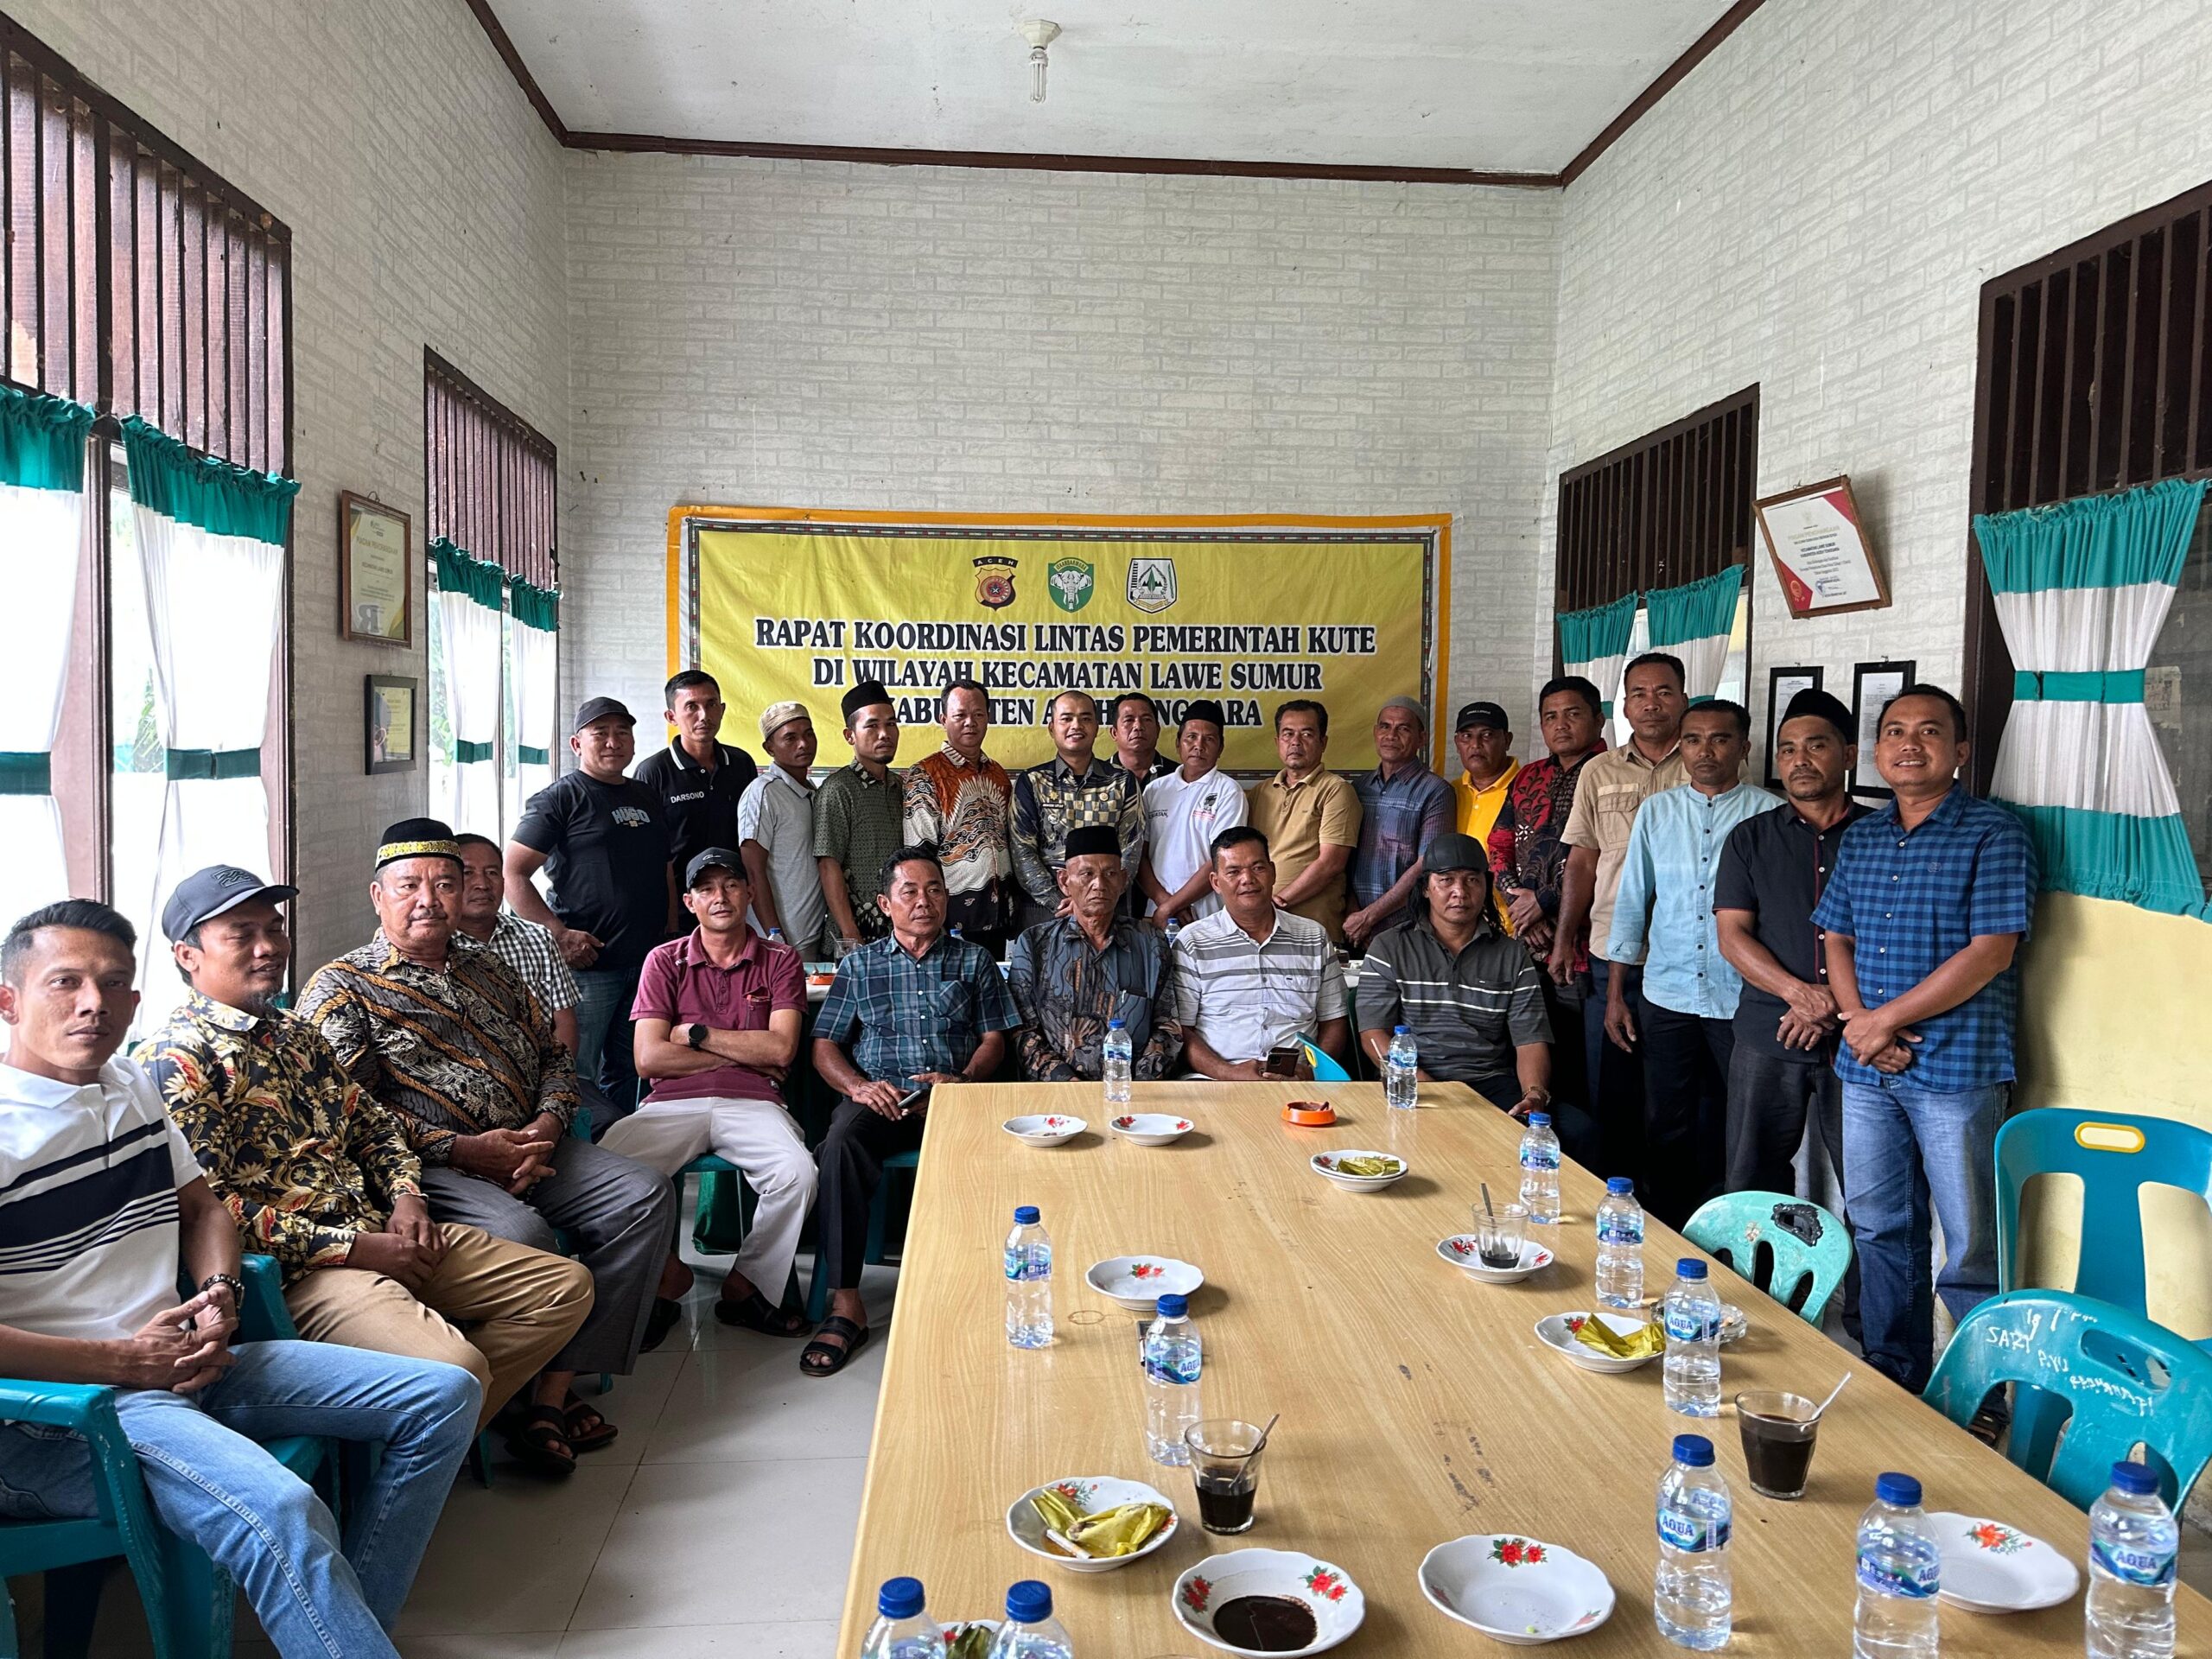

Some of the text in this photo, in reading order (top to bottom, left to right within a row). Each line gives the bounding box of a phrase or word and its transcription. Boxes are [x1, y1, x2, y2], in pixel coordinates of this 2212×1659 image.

[756, 619, 1376, 653] RAPAT KOORDINASI LINTAS PEMERINTAH KUTE
[813, 658, 1323, 690] DI WILAYAH KECAMATAN LAWE SUMUR
[889, 697, 1034, 725] ABUTEN
[1042, 699, 1114, 725] AH
[671, 791, 705, 804] DARSONO
[611, 808, 651, 824] HUGO
[1669, 1316, 1694, 1332] AQUA
[1662, 1515, 1695, 1538] AQUA
[2117, 1550, 2158, 1571] AQUA
